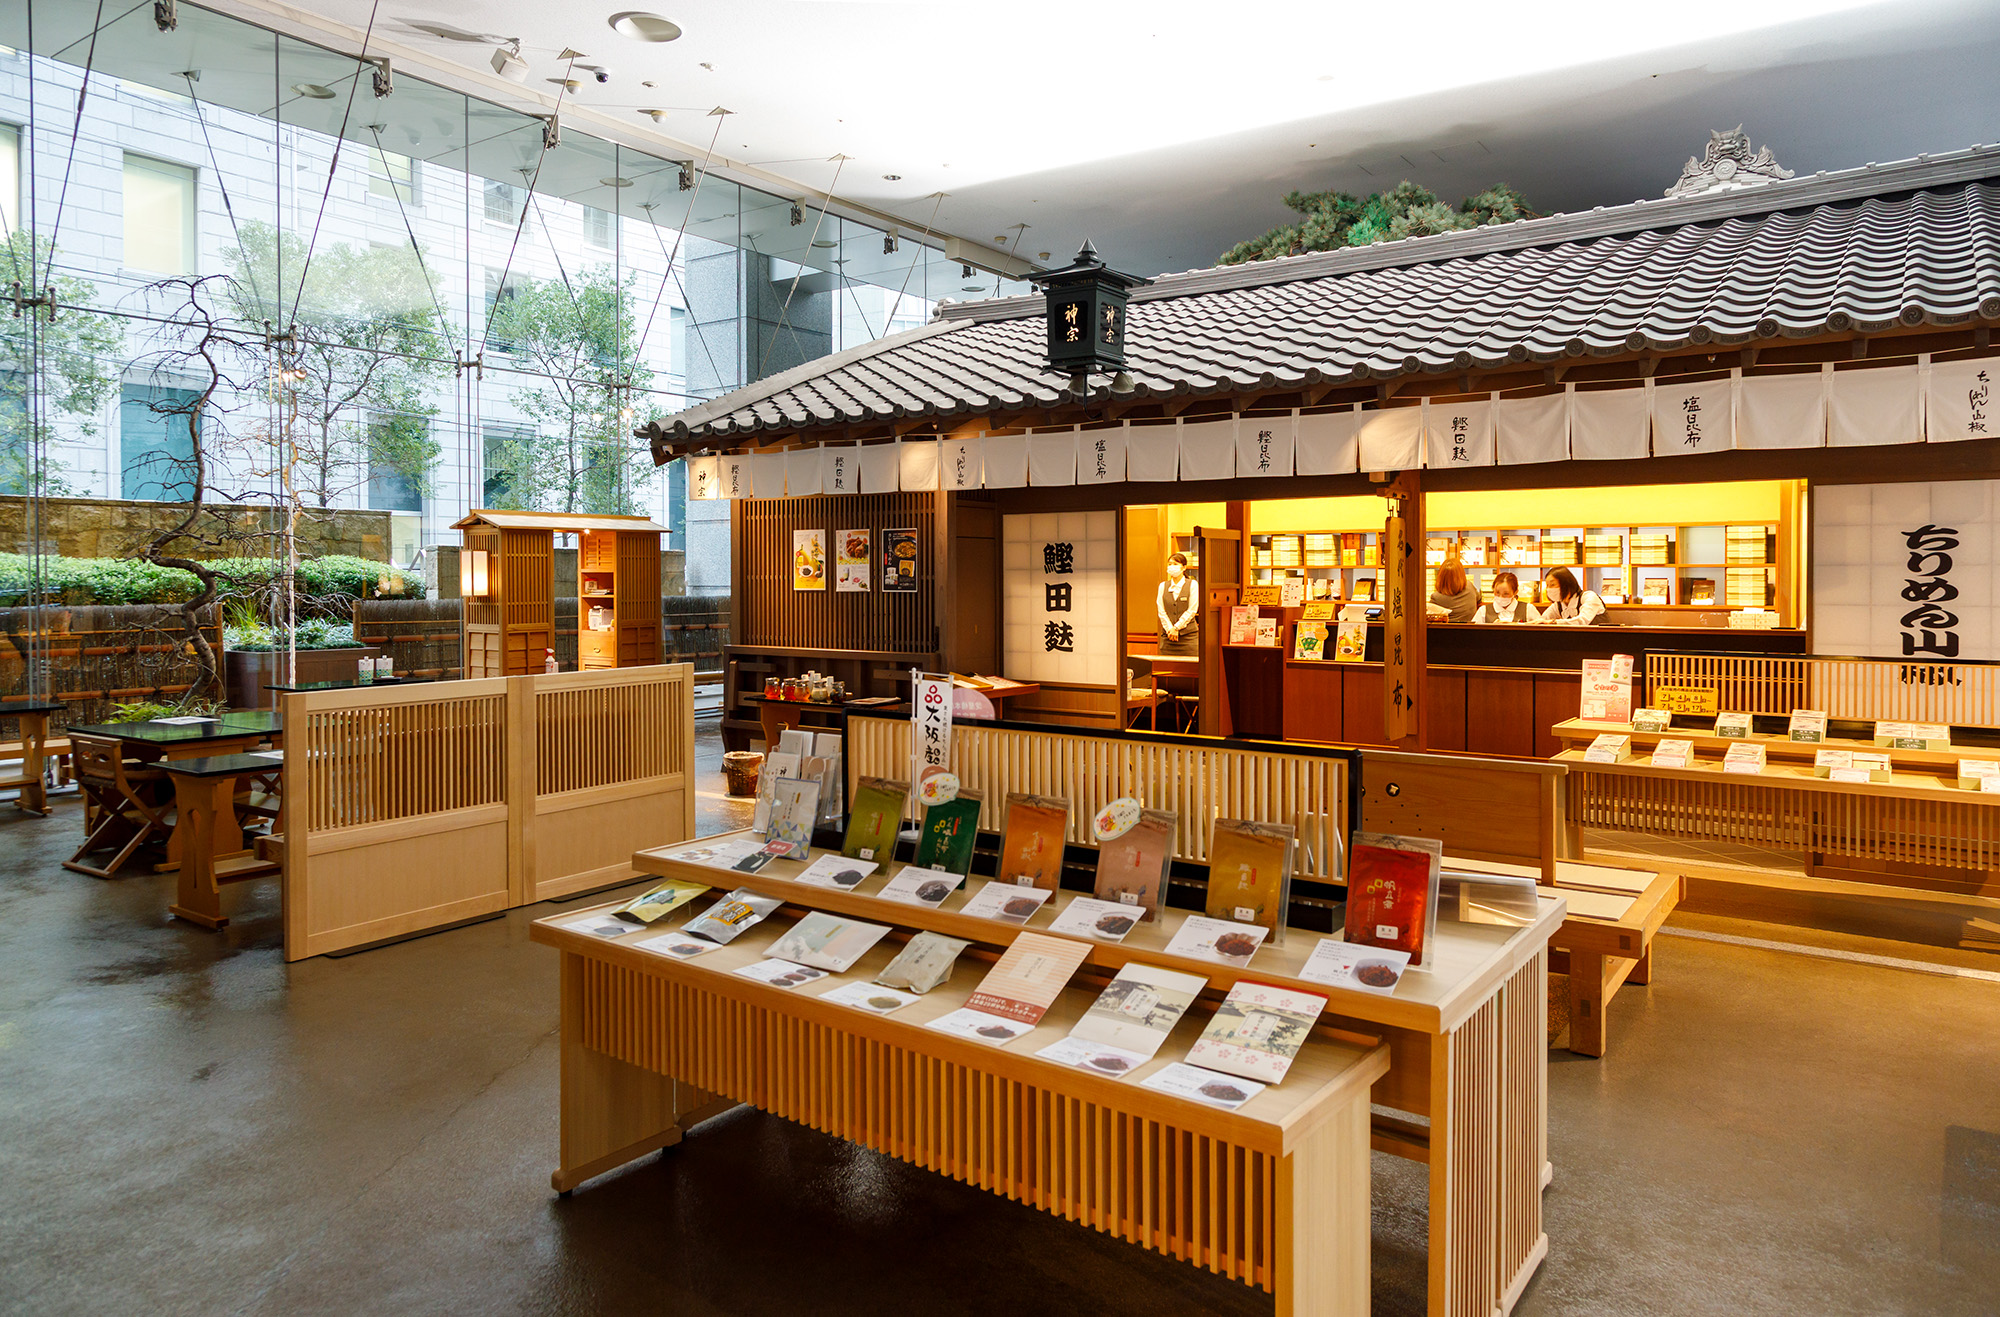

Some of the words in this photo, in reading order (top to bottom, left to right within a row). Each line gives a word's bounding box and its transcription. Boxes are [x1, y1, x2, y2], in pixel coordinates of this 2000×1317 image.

[1065, 303, 1080, 342] 神宗
[1106, 305, 1116, 343] 神宗
[1683, 396, 1702, 448] 塩昆布
[1042, 542, 1074, 653] 鰹田麩
